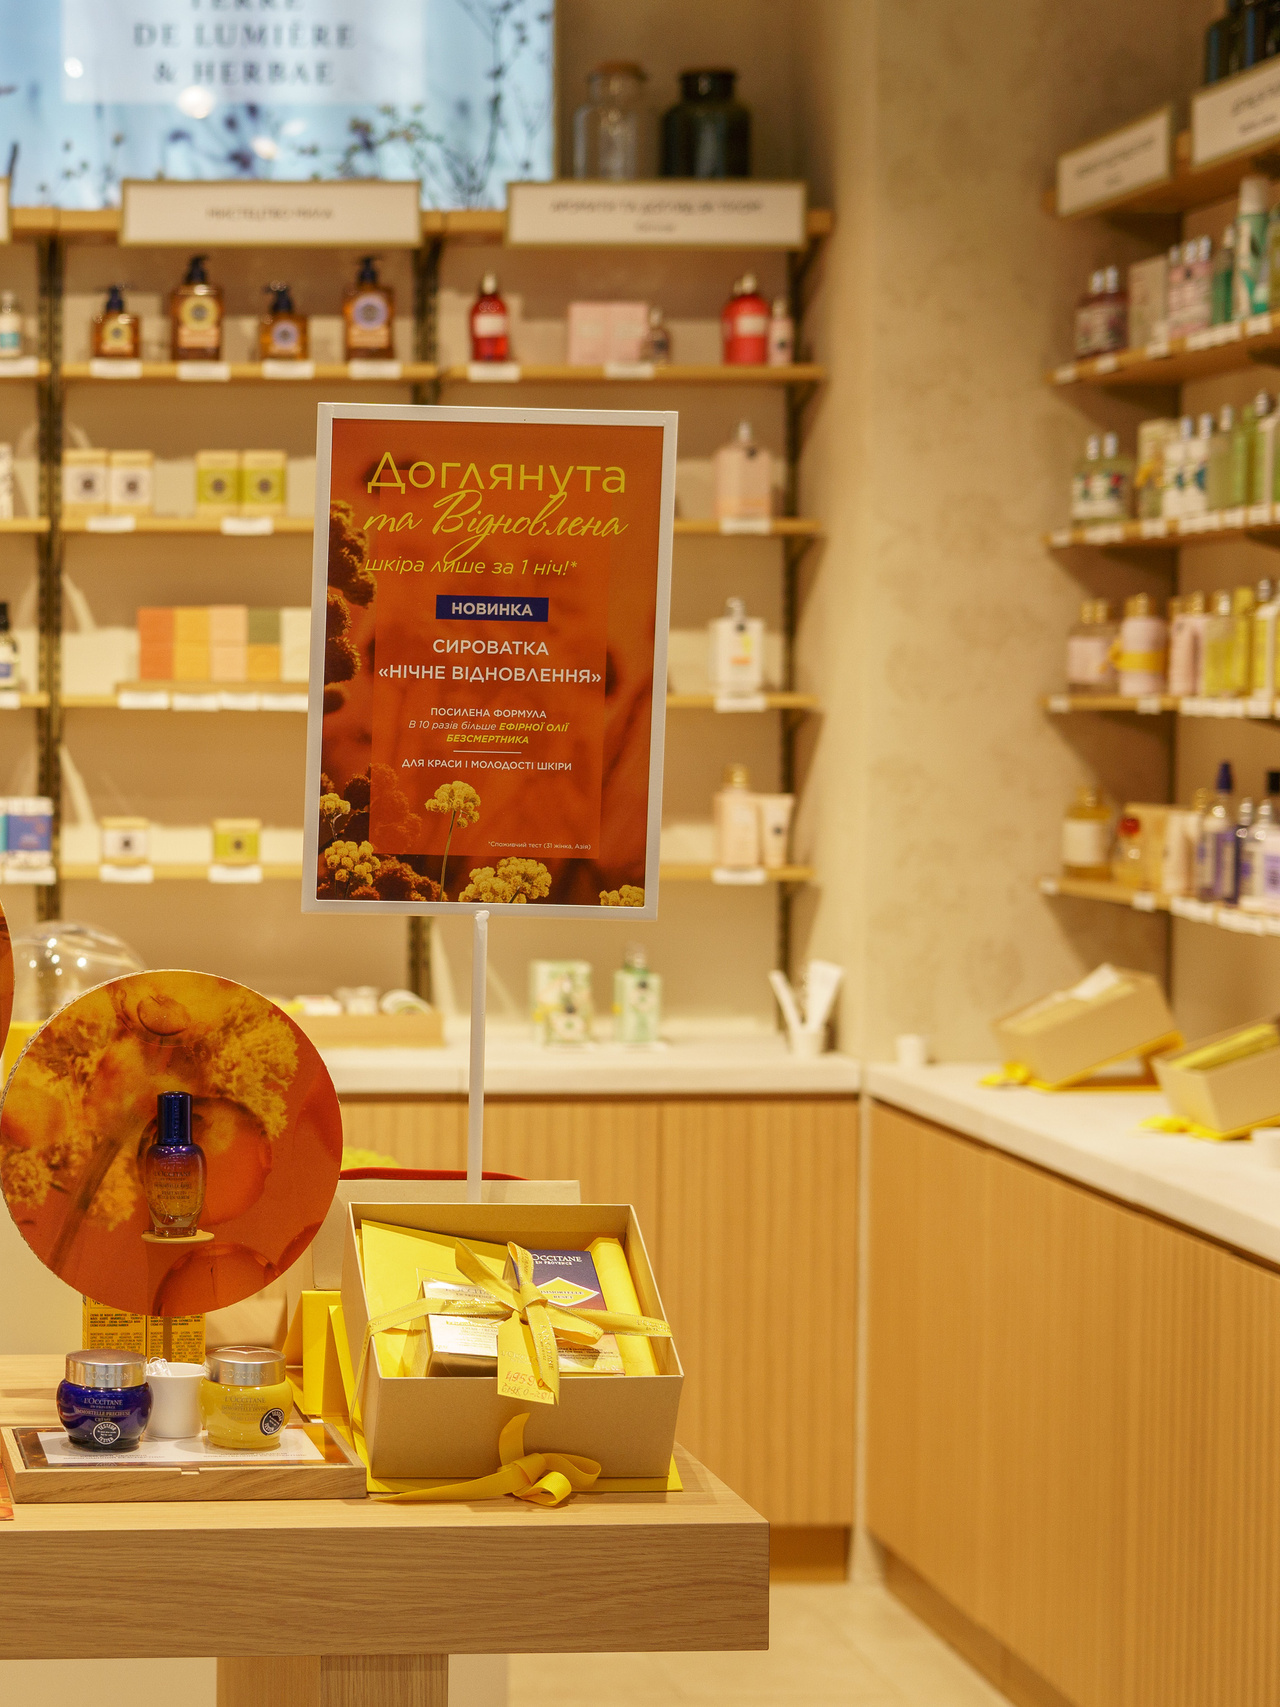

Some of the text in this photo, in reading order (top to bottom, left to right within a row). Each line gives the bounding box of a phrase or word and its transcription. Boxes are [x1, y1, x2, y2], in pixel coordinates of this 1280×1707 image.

[133, 23, 179, 48] DE
[154, 61, 334, 86] & HERBAE
[367, 452, 625, 498] Доглянута
[363, 489, 629, 564] та Відновлена
[365, 556, 425, 575] шкіра
[430, 559, 486, 574] лише
[491, 562, 514, 575] за
[521, 560, 528, 575] 1
[451, 602, 533, 616] НОВИНКА
[433, 639, 549, 656] СИРОВАТКА
[379, 664, 602, 683] «НІЧНЕ ВІДНОВЛЕННЯ»
[430, 707, 547, 719] ПОСИЛЕНА ФОРМУЛА
[408, 720, 570, 732] В 10 разів більше ЕФІРНОЇ ОЛІЇ
[446, 734, 529, 744] БЕЗСМЕРТНИКА
[402, 758, 424, 768] ДЛЯ
[427, 759, 462, 769] КРАСИ
[471, 760, 534, 771] МОЛОДОСТІ
[537, 762, 572, 771] ШКІРИ
[83, 1397, 123, 1406] L'OCCITANE
